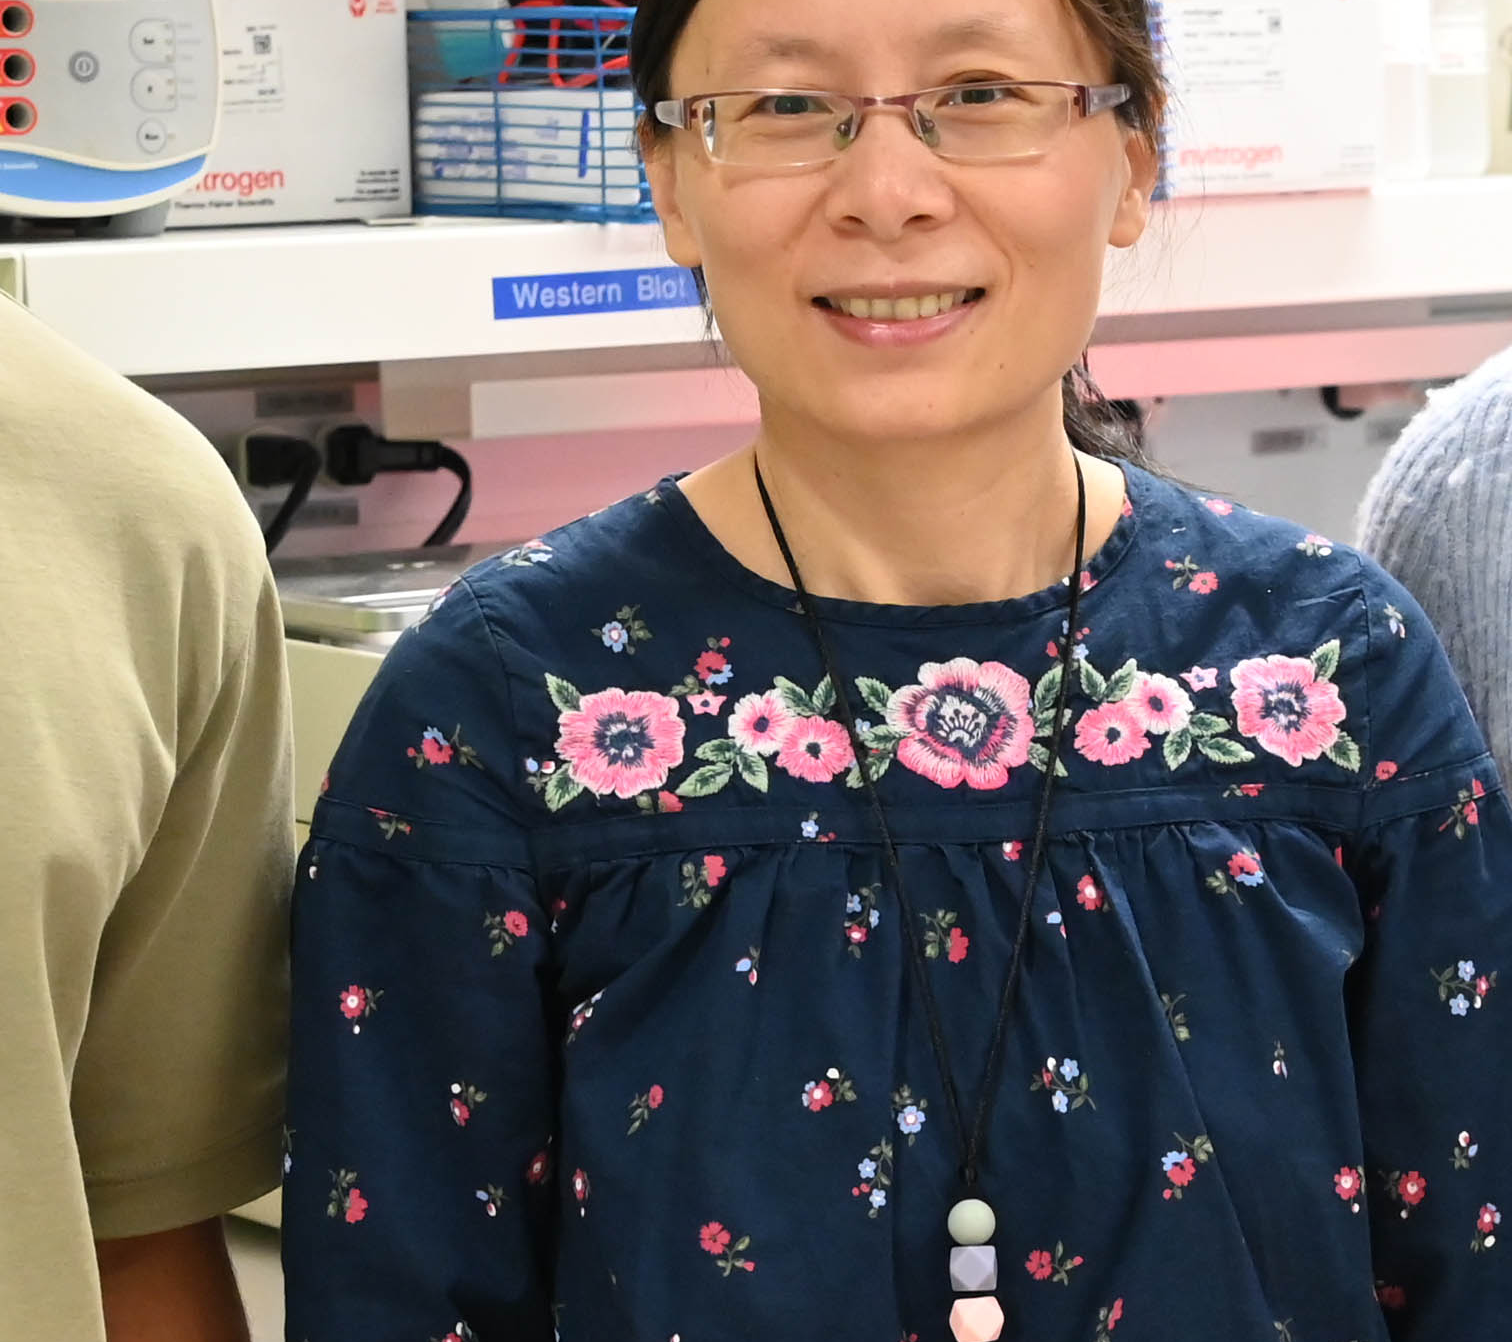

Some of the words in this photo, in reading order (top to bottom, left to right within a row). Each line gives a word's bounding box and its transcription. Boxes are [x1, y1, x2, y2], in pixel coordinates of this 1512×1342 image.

[1180, 144, 1285, 171] invitrogen
[512, 282, 622, 309] Western
[637, 275, 686, 302] Blot
